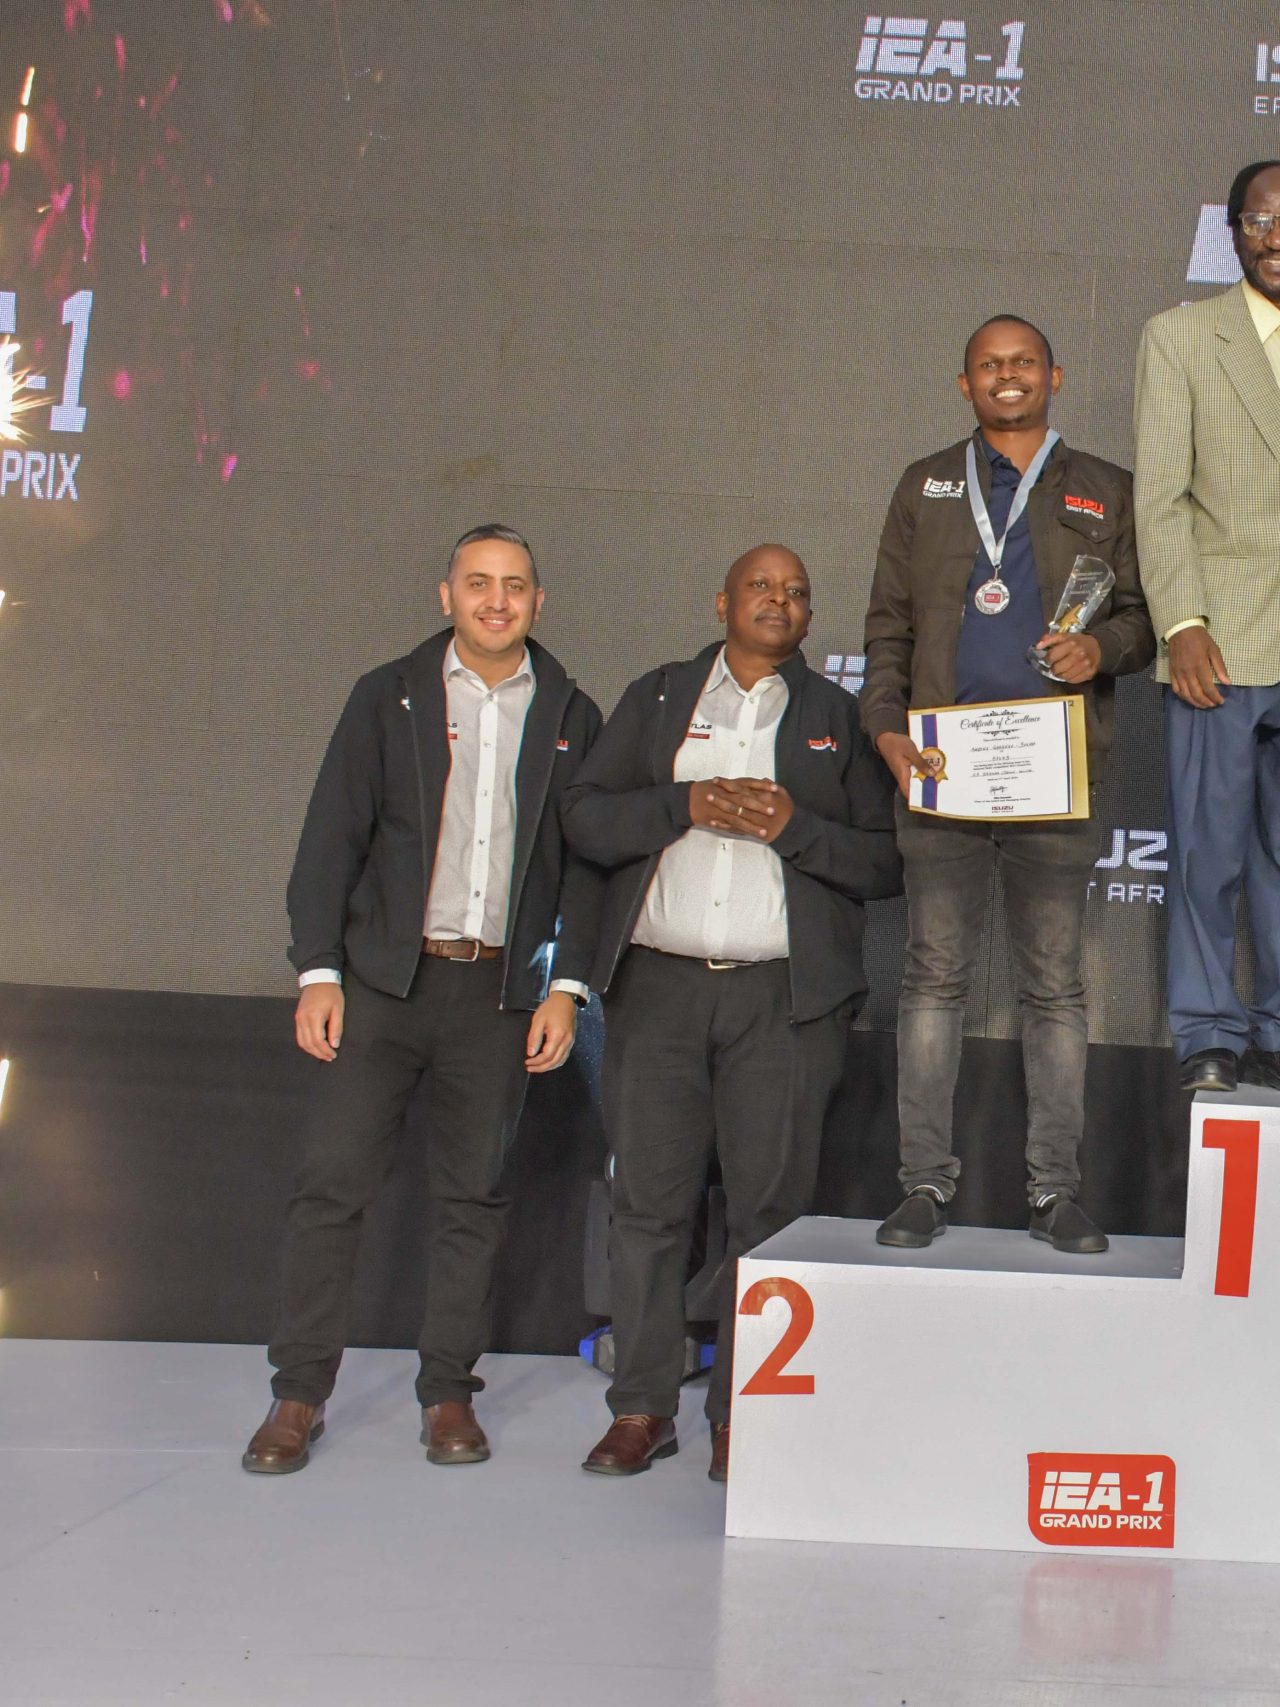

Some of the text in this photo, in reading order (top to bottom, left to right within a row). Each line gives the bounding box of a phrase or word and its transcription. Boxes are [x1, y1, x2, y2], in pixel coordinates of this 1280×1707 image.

[855, 79, 1021, 106] GRAND PRIX
[0, 450, 81, 502] PRIX
[1065, 495, 1104, 514] ISUZU
[960, 715, 1041, 731] Certificate of Excellence
[1202, 1118, 1260, 1298] 1
[739, 1277, 815, 1395] 2
[1040, 1513, 1162, 1530] GRAND PRIX
